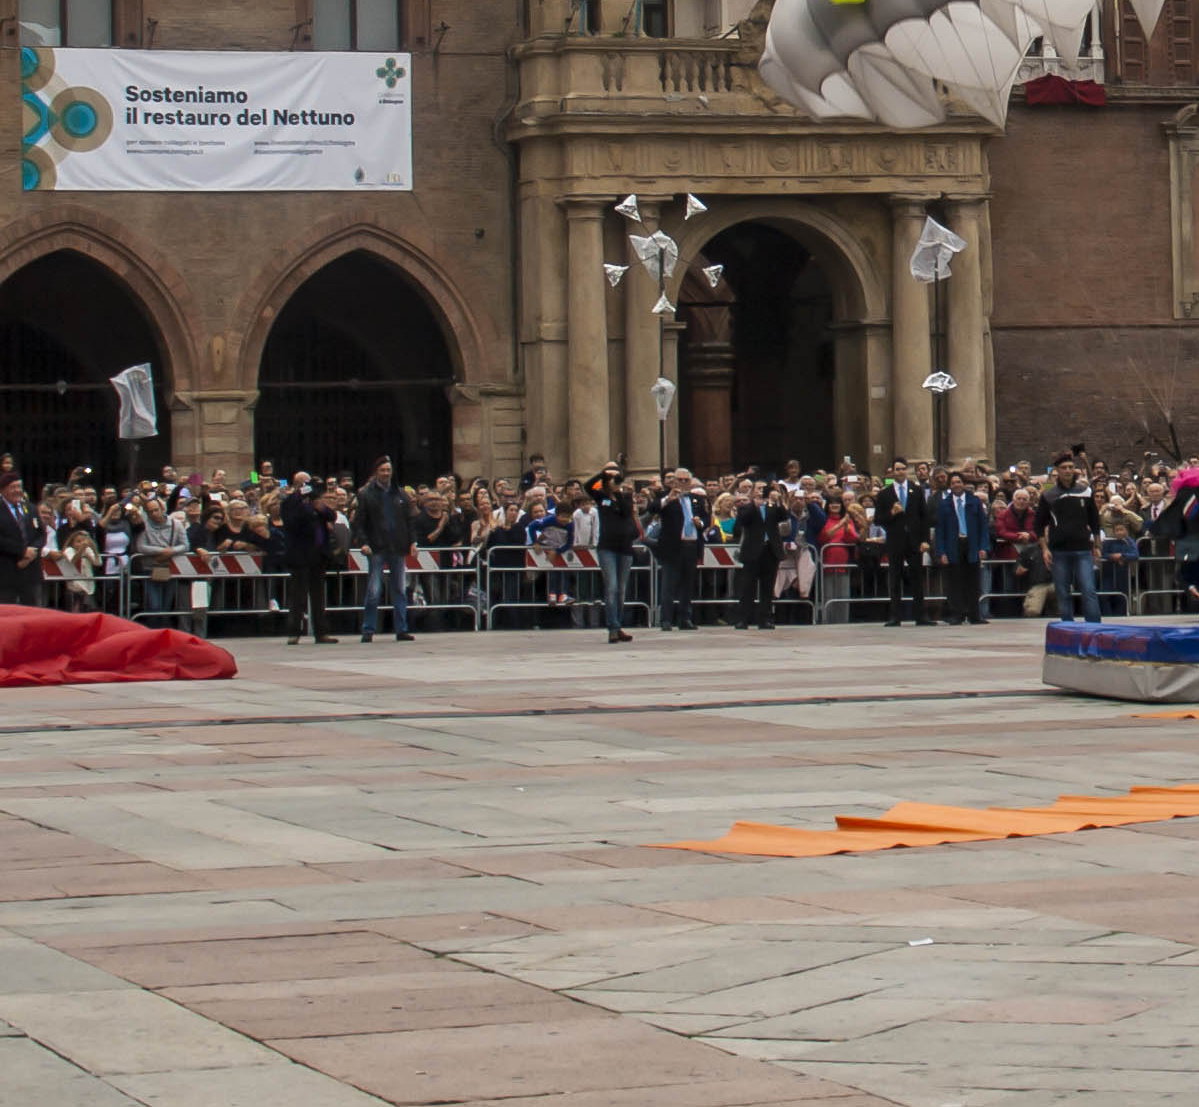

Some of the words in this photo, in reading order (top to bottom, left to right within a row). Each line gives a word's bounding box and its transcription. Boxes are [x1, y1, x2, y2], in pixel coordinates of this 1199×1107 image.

[125, 85, 248, 104] Sosteniamo
[125, 107, 138, 125] il
[143, 109, 231, 126] restauro
[236, 109, 267, 126] del
[273, 109, 355, 127] Nettuno
